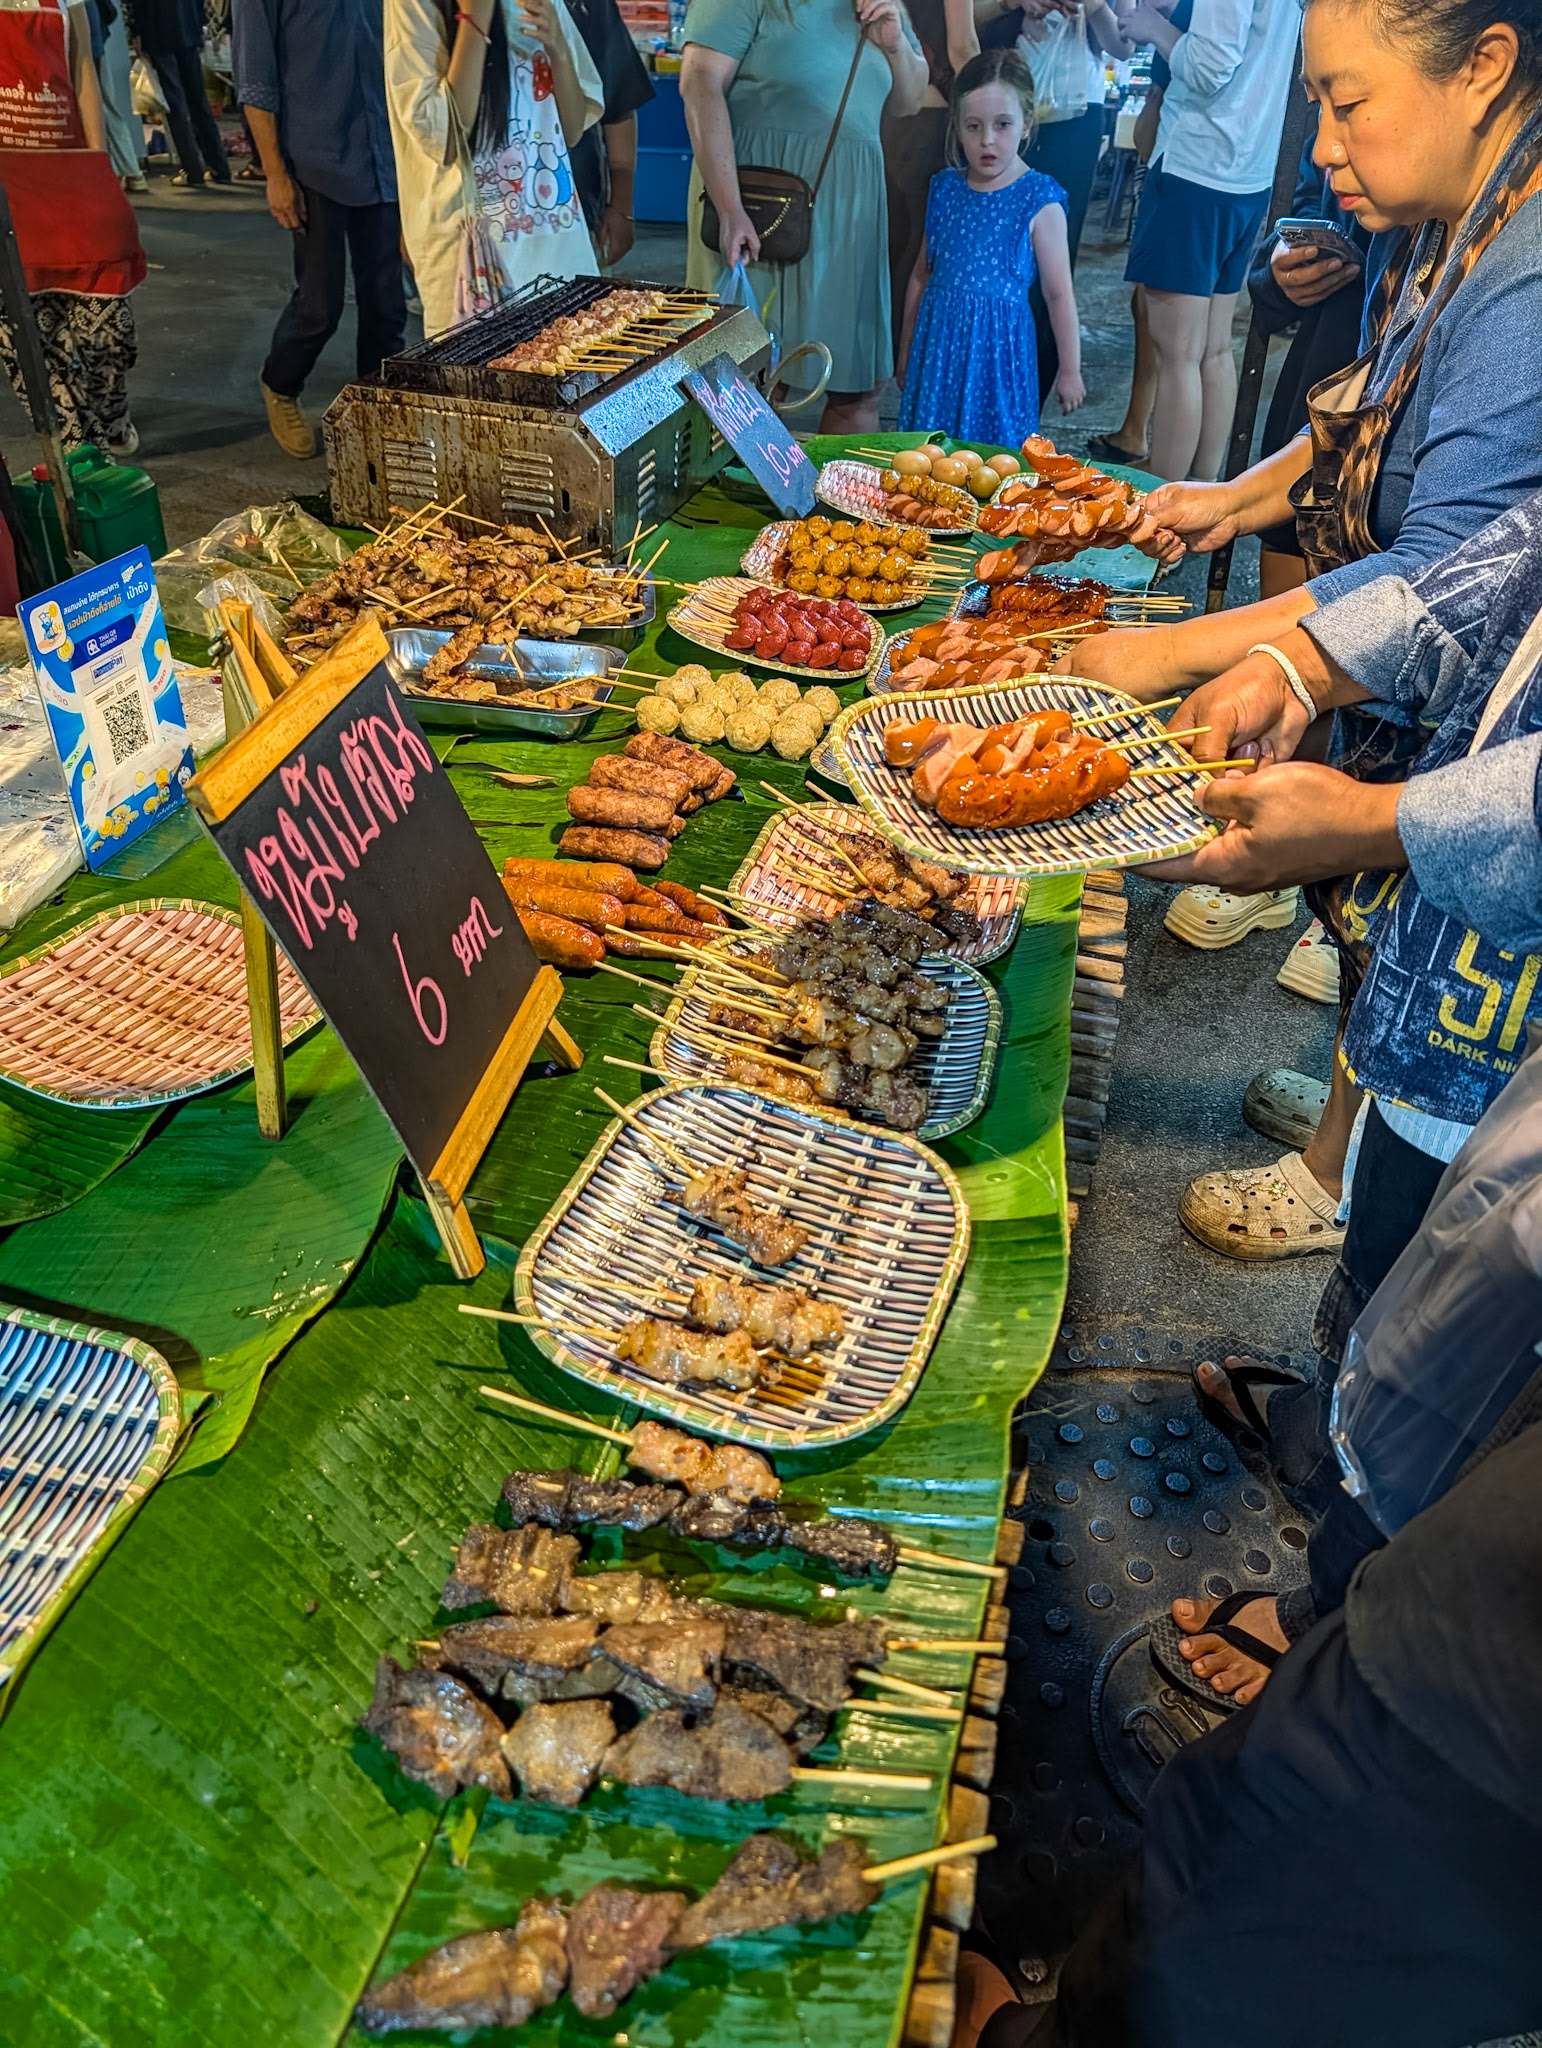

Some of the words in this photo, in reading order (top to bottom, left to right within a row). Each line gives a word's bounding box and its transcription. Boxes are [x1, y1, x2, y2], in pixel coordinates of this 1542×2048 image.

[126, 581, 149, 600] เป๋าตัง
[100, 636, 118, 648] PAYMENT
[392, 932, 449, 1046] 6
[1428, 1030, 1490, 1065] DARK
